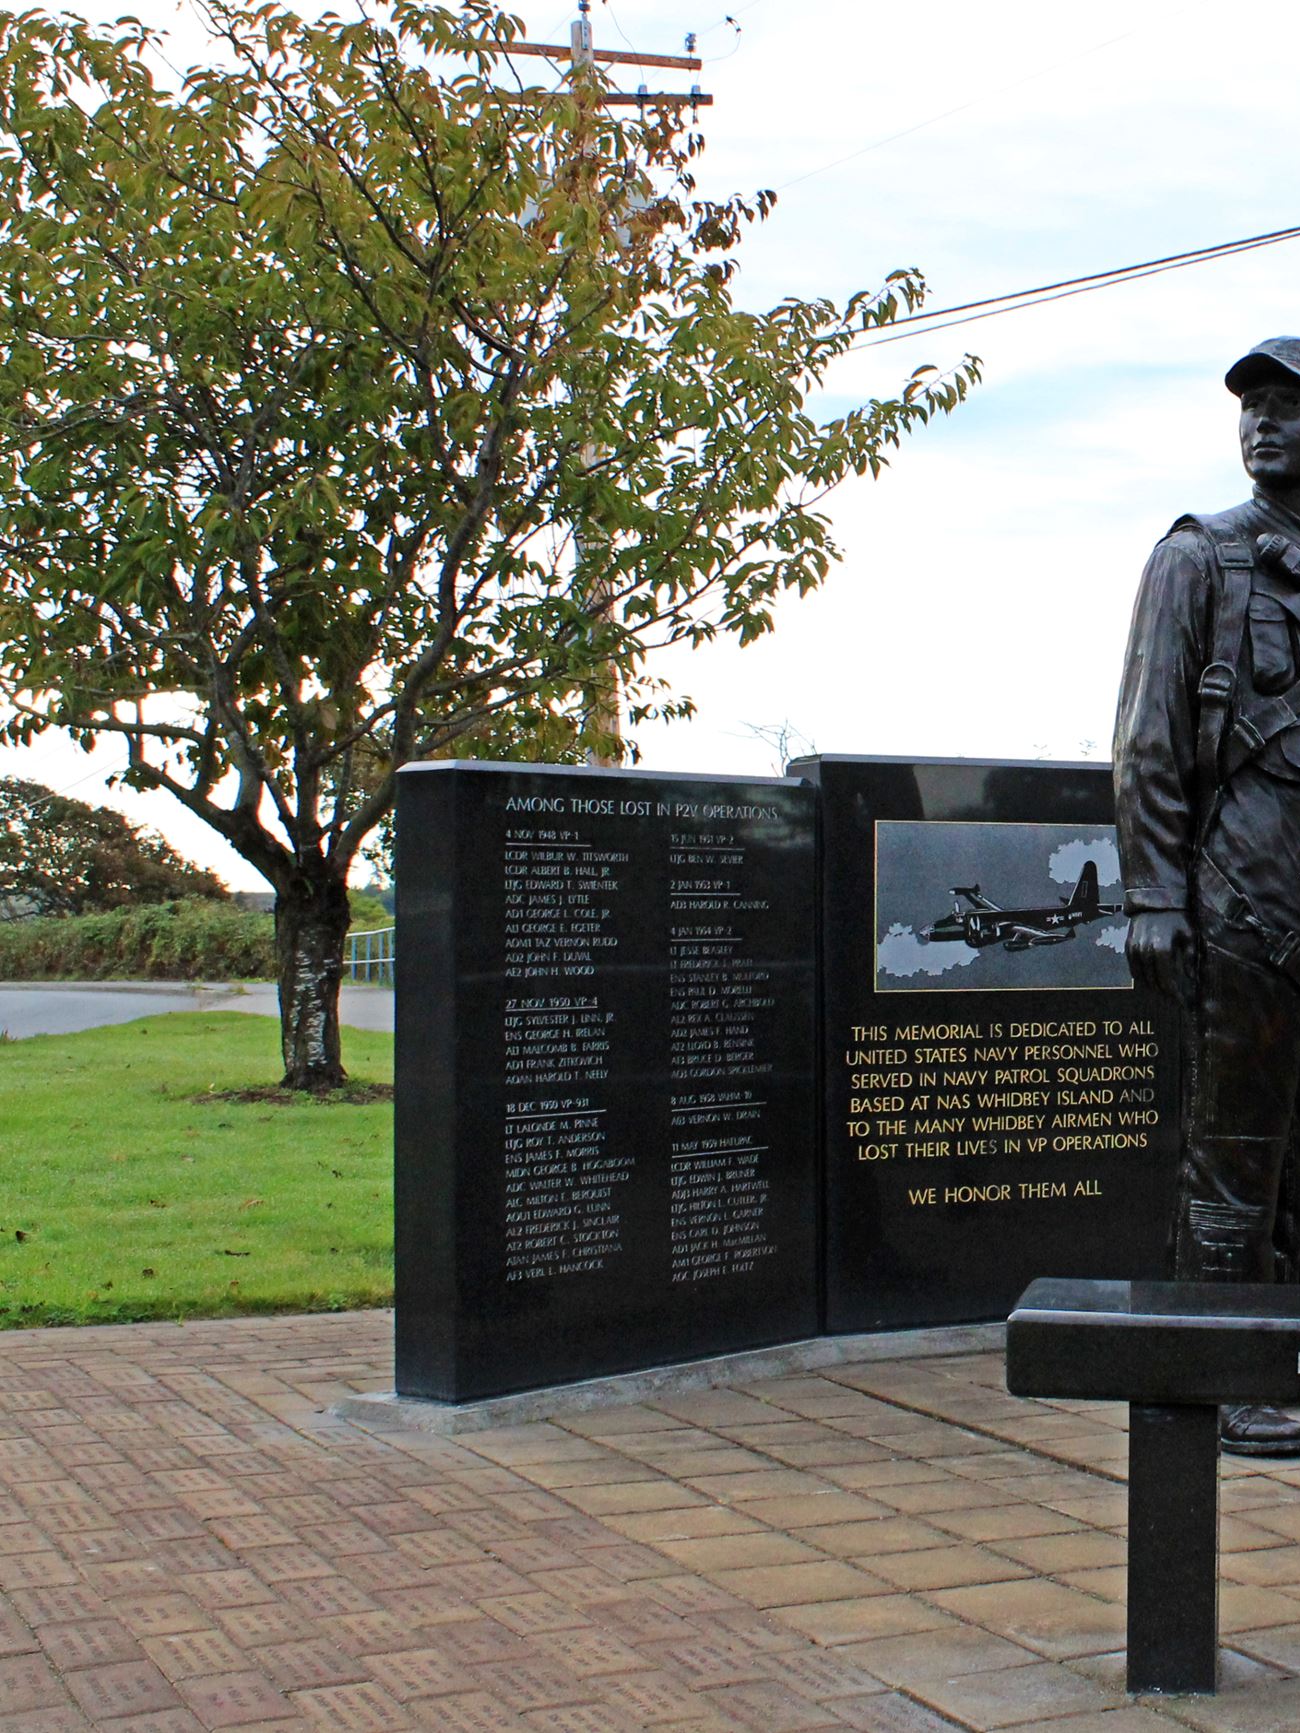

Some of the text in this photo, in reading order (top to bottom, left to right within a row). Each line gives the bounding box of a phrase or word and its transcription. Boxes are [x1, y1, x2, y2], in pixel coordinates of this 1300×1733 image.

[505, 796, 778, 820] AMONG THOSE LOST IN P2V OPERATIONS
[505, 829, 511, 837] 4
[514, 829, 534, 838] NOV
[538, 830, 556, 839] 1948
[504, 850, 528, 859] LCDR
[531, 851, 564, 860] WILBUR
[582, 852, 628, 861] TITSWORTH
[504, 879, 522, 890] LTJG
[525, 880, 564, 889] EDWARD
[504, 894, 525, 903] ADC
[528, 894, 556, 905] JAMES
[567, 894, 589, 903] LYTLE
[504, 908, 560, 918] AD1 GEORGE
[535, 937, 551, 947] TAZ
[553, 937, 590, 946] VERNON
[592, 937, 618, 946] RUDD
[504, 952, 524, 962] AD2
[526, 952, 550, 963] JOHN
[563, 951, 592, 961] DUVAL
[524, 966, 548, 977] JOHN
[563, 965, 594, 975] WOOD
[505, 998, 517, 1009] 27
[520, 998, 545, 1009] NOV
[548, 997, 570, 1008] 1950
[504, 1016, 523, 1027] LTJG
[525, 1014, 569, 1025] SYLVESTER
[850, 1020, 1154, 1041] THIS MEMORIAL IS DEDICATED TO ALL
[845, 1042, 1158, 1065] UNITED STATES NAVY PERSONNEL WHO
[851, 1065, 1154, 1088] SERVED IN NAVY PATROL SQUADRONS
[506, 1103, 516, 1113] 18
[517, 1101, 536, 1112] DEC
[539, 1099, 558, 1110] 1950
[850, 1088, 1154, 1113] BASED AT NAS WHIDBEY ISLAND AND
[846, 1110, 1158, 1137] TO THE MANY WHIDBEY AIRMEN WHO
[504, 1138, 523, 1149] LTJG
[525, 1136, 544, 1147] ROY
[557, 1131, 605, 1143] ANDERSON
[858, 1132, 1147, 1160] LOST THEIR LIVES IN VP OPERATIONS
[504, 1152, 523, 1163] ENS
[525, 1150, 553, 1161] JAMES
[566, 1145, 599, 1157] MORRIS
[908, 1179, 1102, 1204] WE HONOR THEM ALL
